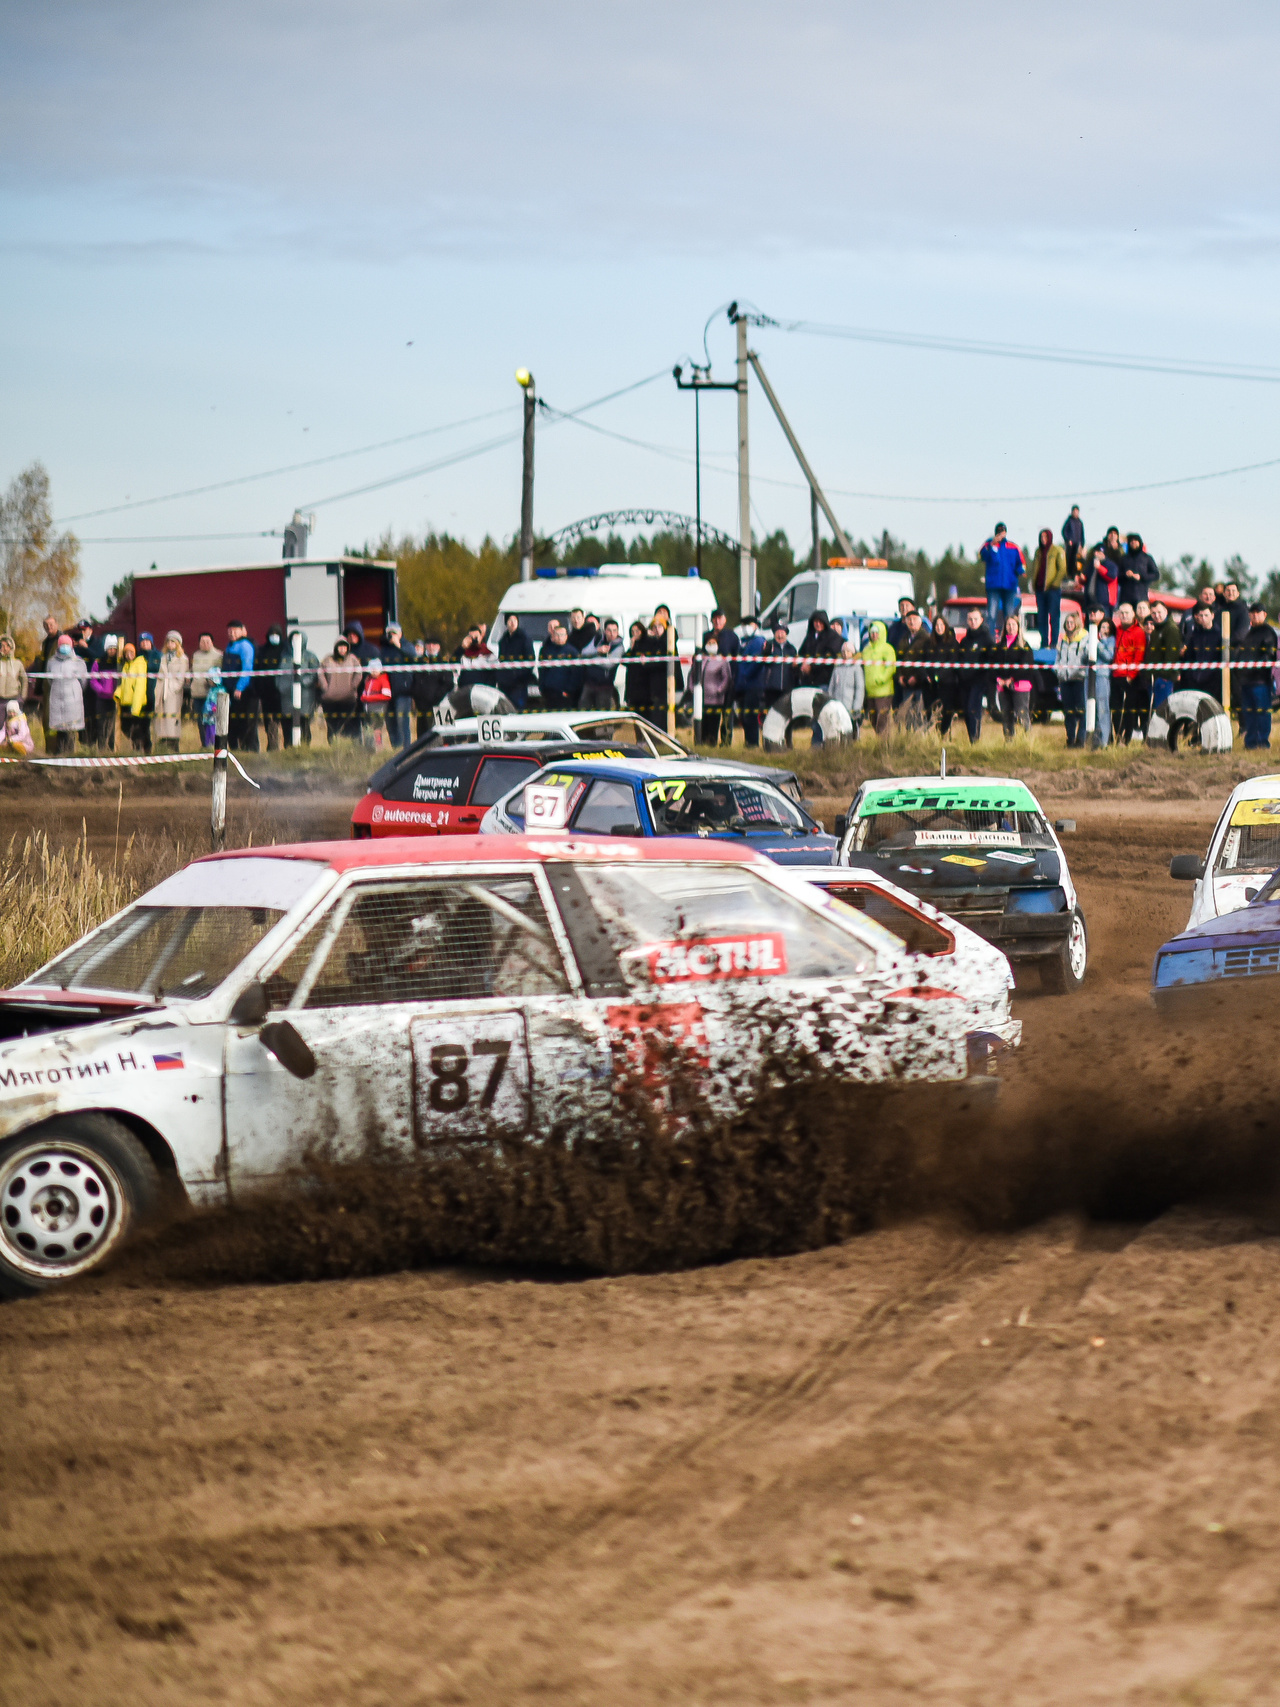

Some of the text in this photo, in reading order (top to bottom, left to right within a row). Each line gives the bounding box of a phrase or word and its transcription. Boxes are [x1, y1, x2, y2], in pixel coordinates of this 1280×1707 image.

[435, 709, 453, 726] 14
[482, 719, 502, 741] 66
[648, 780, 687, 802] 17
[532, 794, 559, 817] 87
[384, 809, 450, 827] autocross_21
[655, 938, 780, 977] MOTUL
[0, 1051, 146, 1087] Мяготин Н.
[429, 1040, 512, 1113] 87
